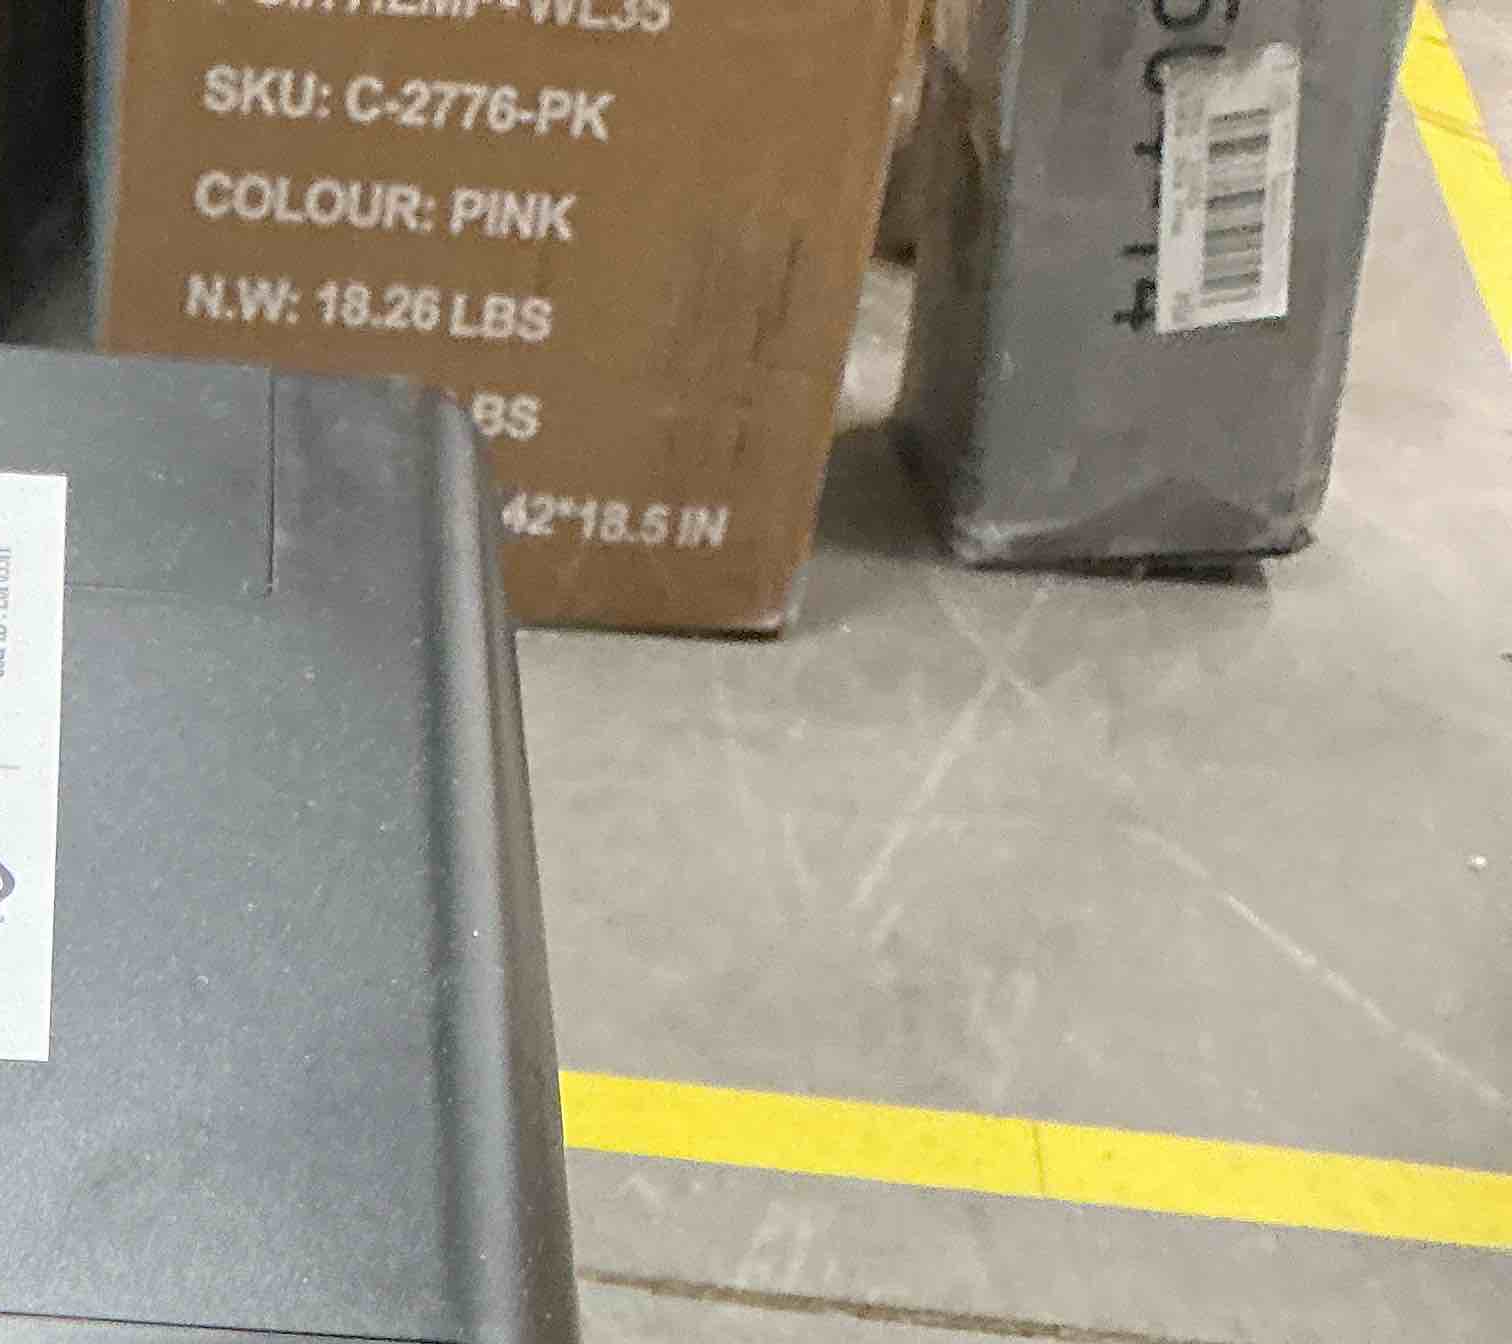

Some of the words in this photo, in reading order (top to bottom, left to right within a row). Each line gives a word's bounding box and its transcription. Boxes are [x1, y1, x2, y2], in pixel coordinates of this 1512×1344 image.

[203, 64, 331, 120] SKU:
[344, 74, 616, 142] C-2776-PK
[194, 170, 435, 234] COLOUR:
[449, 187, 576, 242] PINK
[186, 273, 300, 326] N.W:
[315, 280, 440, 333] 18.26
[448, 291, 553, 344] LBS
[472, 390, 542, 442] BS
[677, 502, 729, 547] IN
